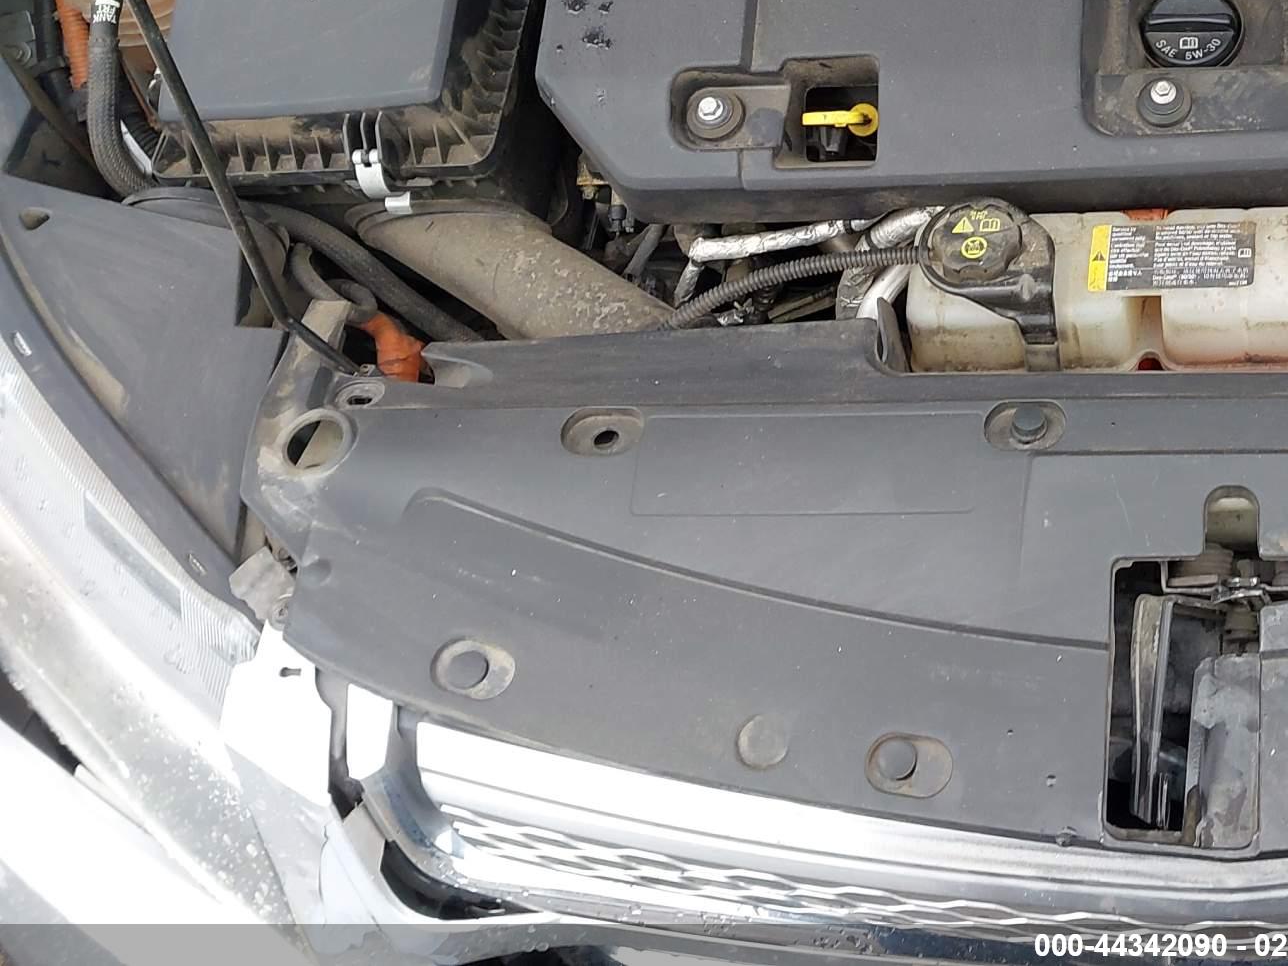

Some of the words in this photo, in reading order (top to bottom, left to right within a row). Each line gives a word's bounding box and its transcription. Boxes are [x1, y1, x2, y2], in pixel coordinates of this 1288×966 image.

[92, 14, 117, 24] TANK
[1155, 39, 1178, 58] SAE
[1185, 38, 1221, 60] 5W-30
